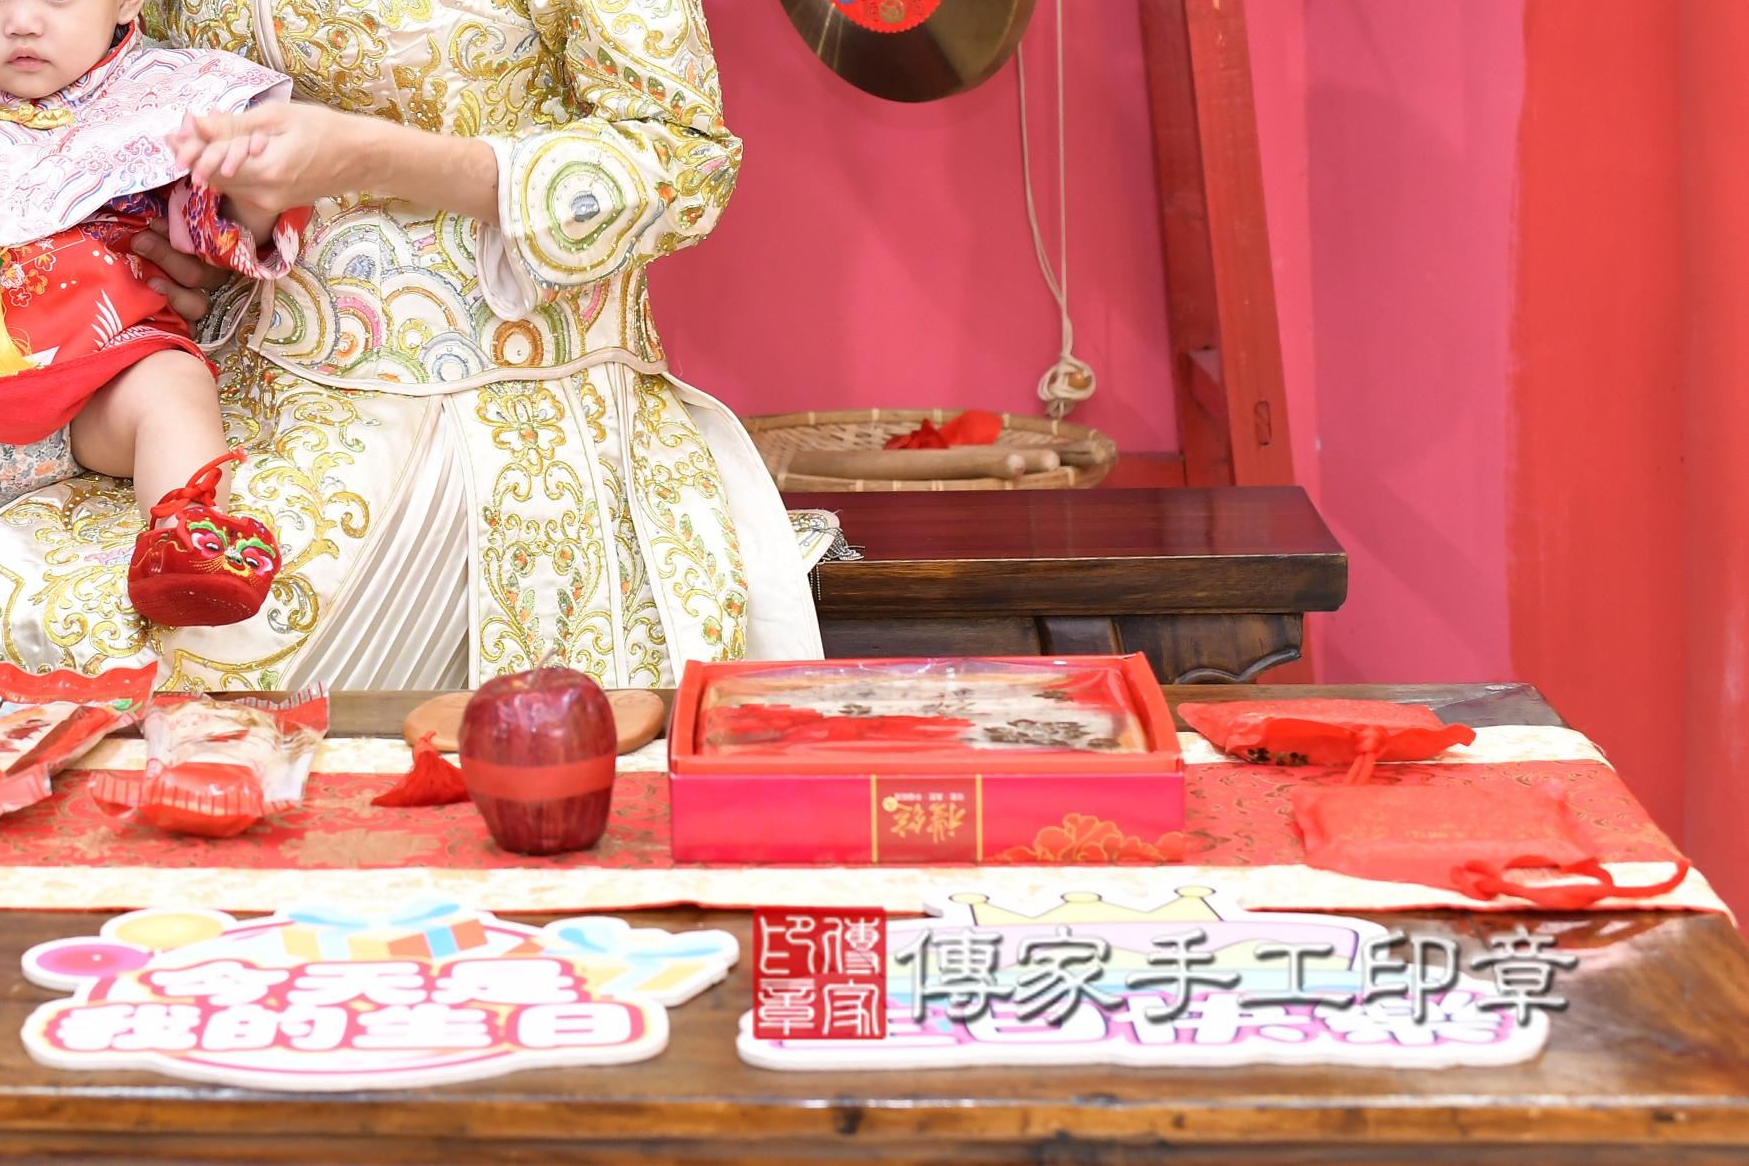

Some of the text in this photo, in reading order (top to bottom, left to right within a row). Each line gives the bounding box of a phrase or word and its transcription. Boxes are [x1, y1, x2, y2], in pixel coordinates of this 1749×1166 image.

[150, 958, 580, 1006] 今天是
[55, 1002, 633, 1050] 我的生日
